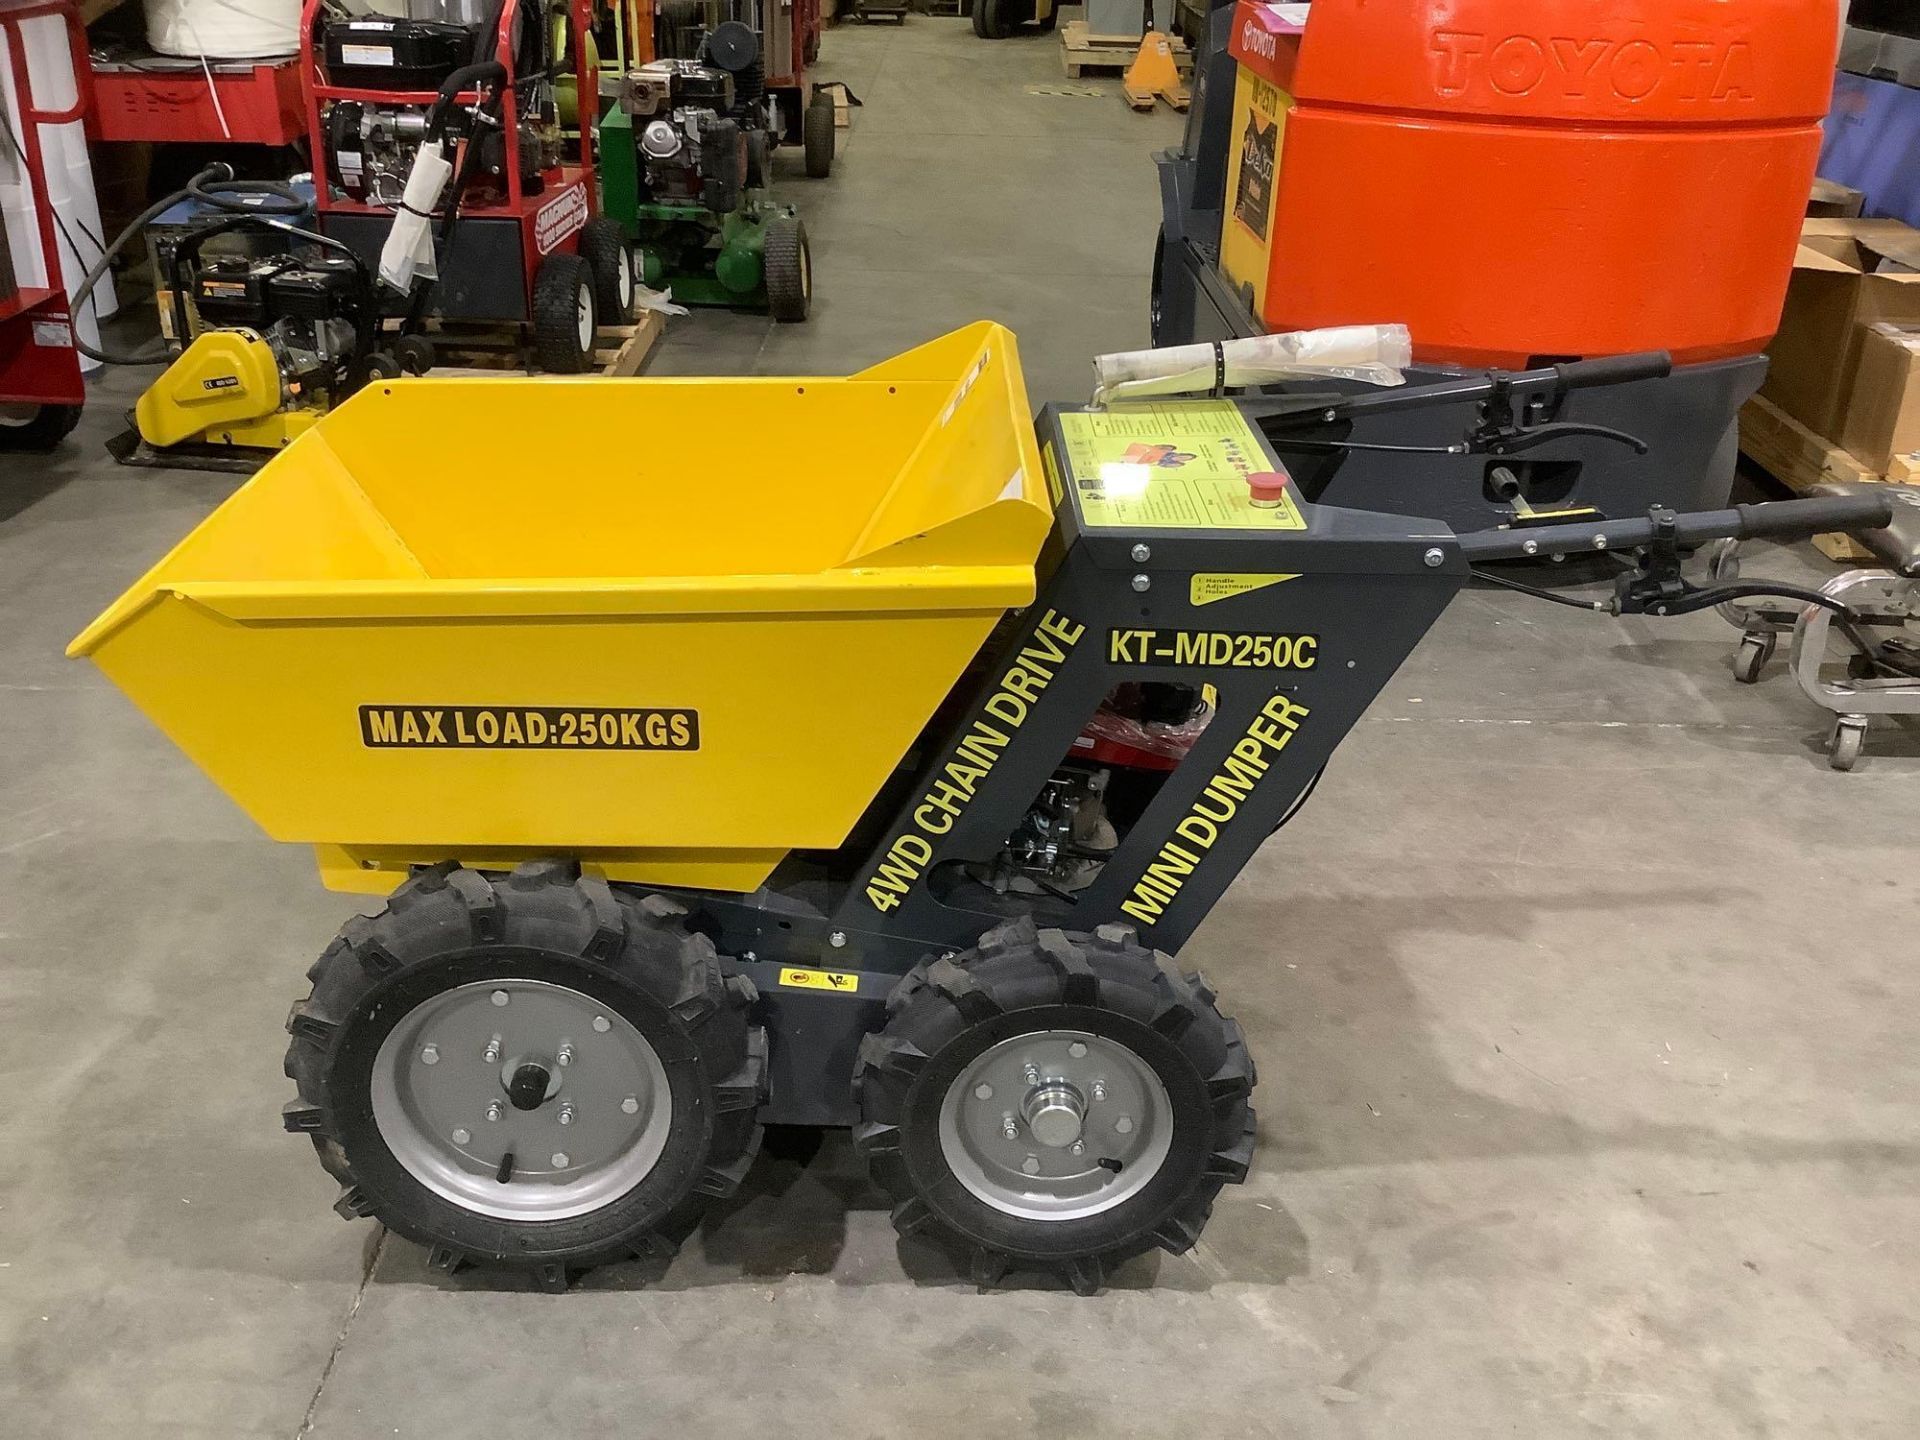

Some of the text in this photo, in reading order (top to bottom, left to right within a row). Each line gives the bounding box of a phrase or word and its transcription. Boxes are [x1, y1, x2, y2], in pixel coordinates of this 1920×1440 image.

[1251, 25, 1277, 62] TOYOTA
[1433, 30, 1756, 103] TOYOTA
[1110, 629, 1317, 669] KT-MD250C
[368, 710, 691, 746] MAX LOAD:250KGS
[866, 608, 1087, 912] 4WD CHAIN DRIVE
[1120, 695, 1311, 925] MINI DUMPER
